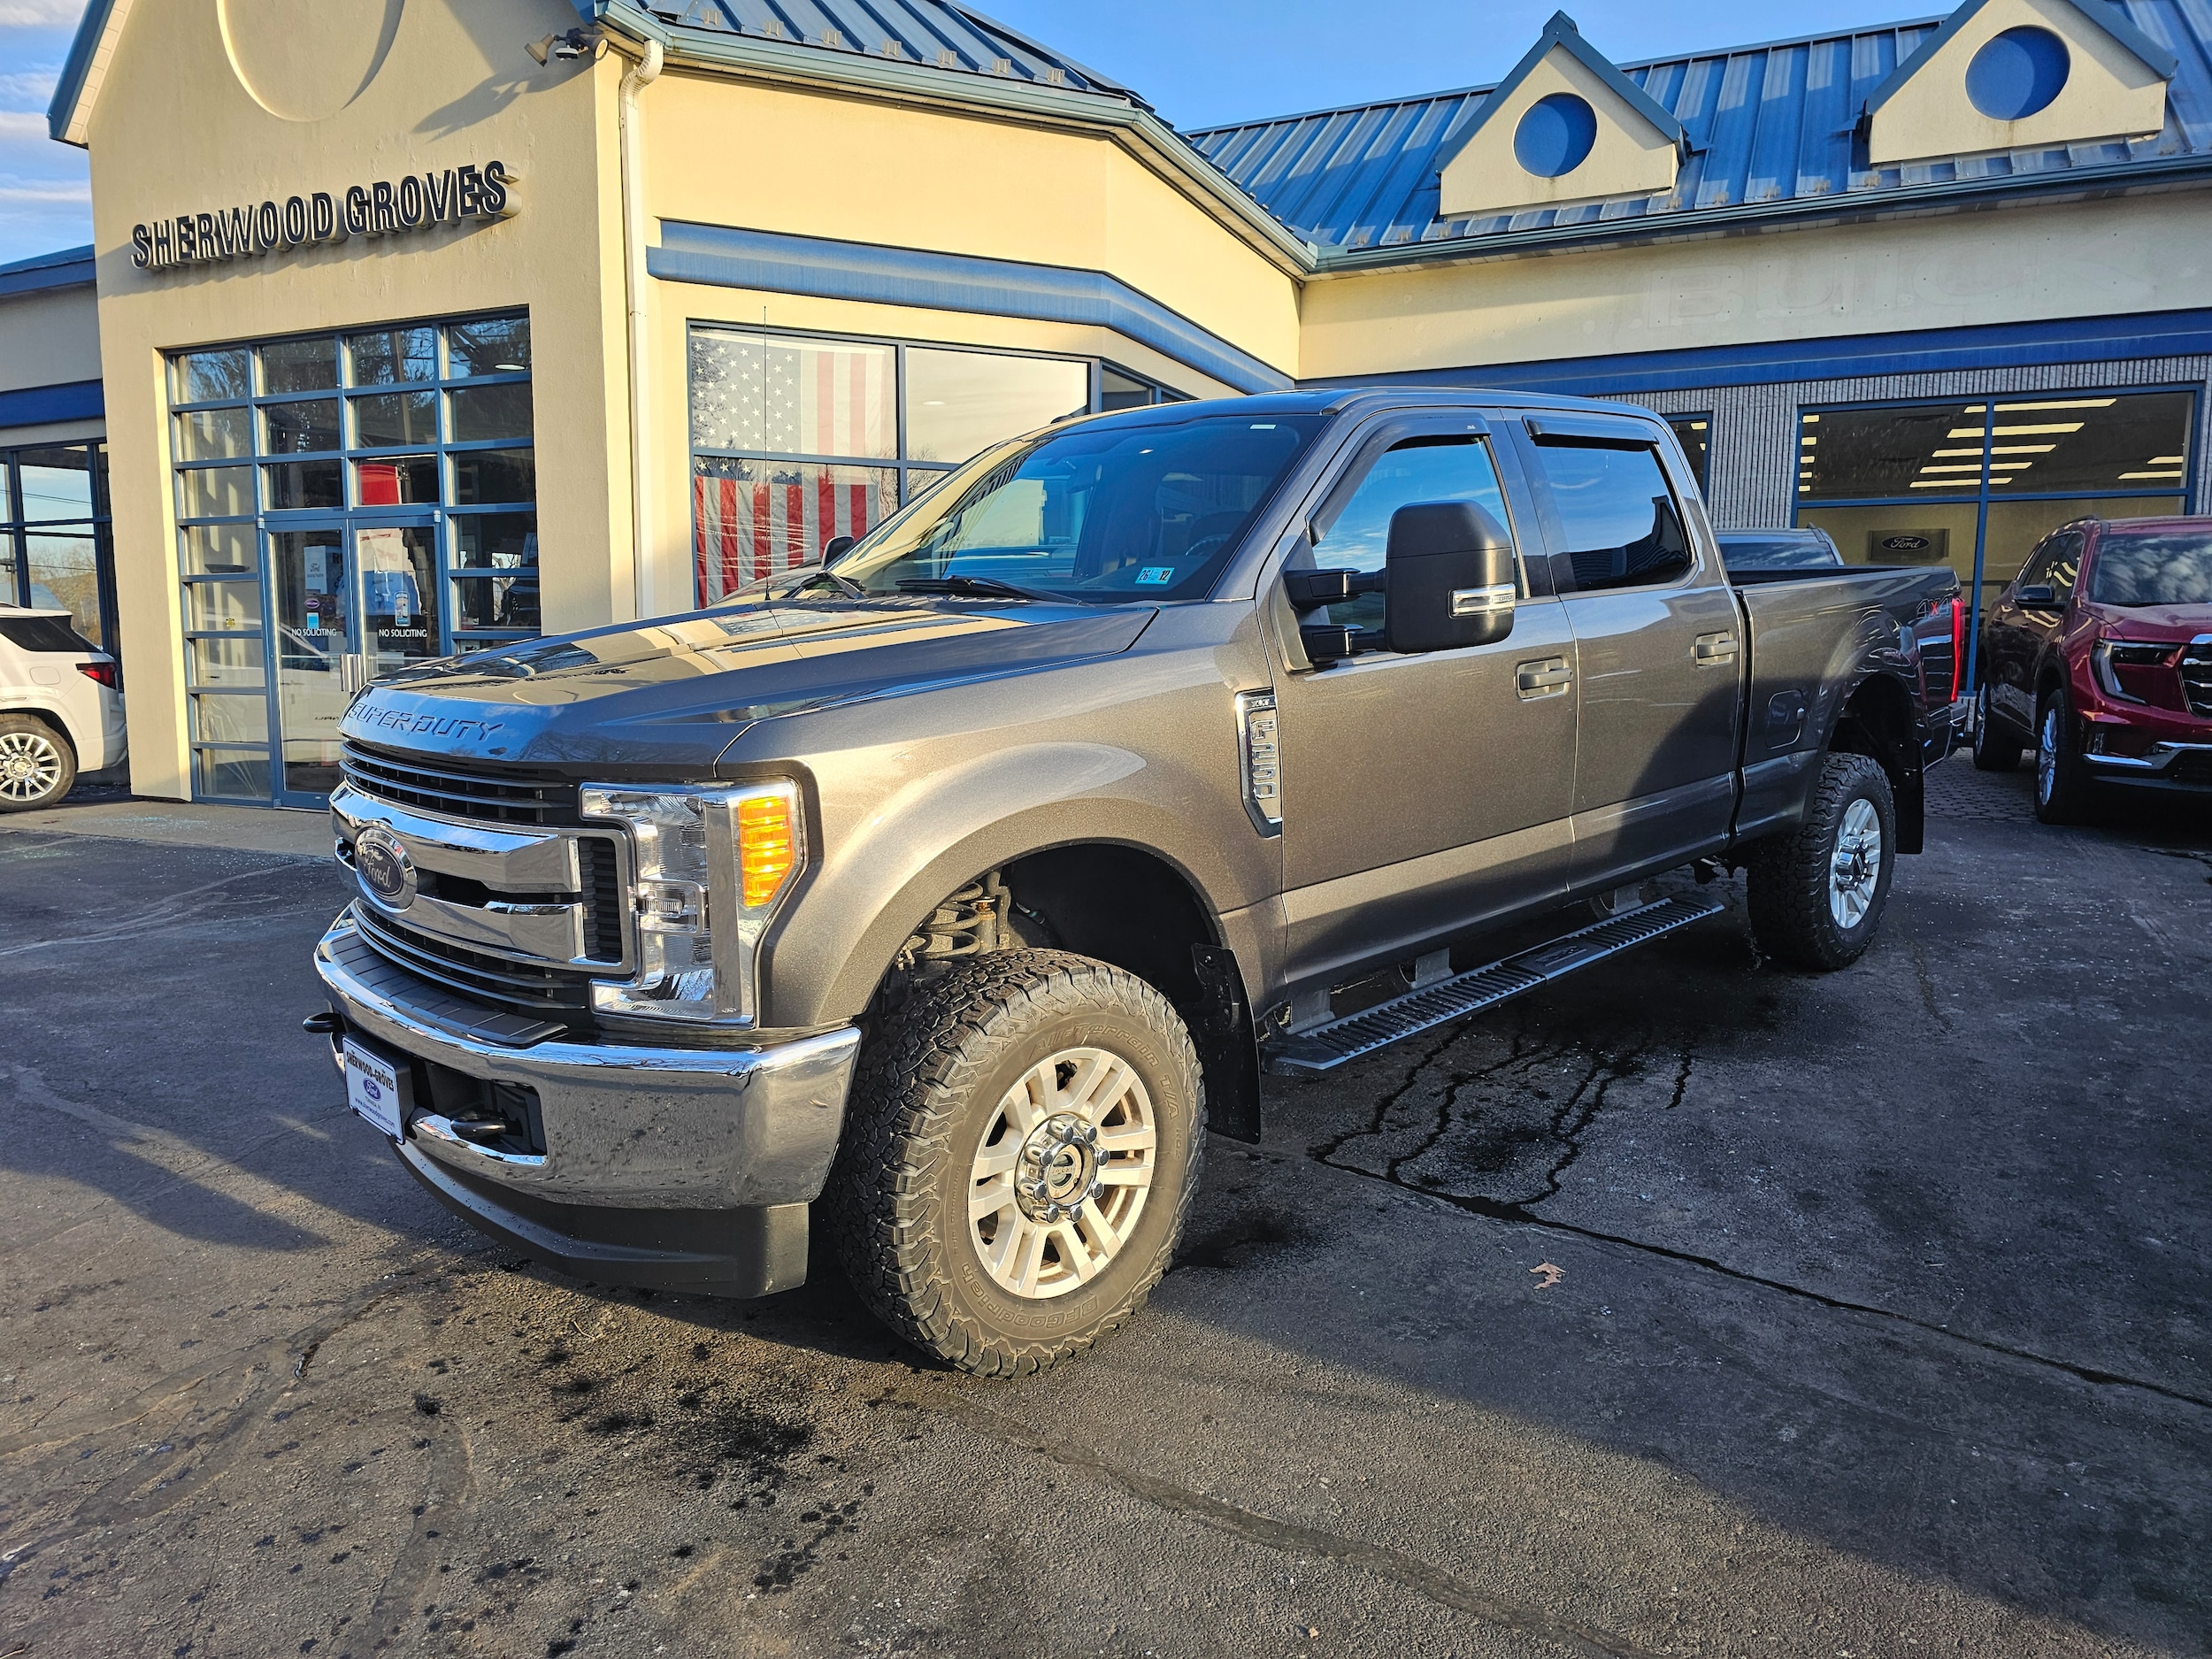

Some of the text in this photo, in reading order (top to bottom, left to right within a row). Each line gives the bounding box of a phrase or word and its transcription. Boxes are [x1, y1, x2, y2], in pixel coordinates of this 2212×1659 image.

[131, 160, 511, 269] SHERWOOD GROVES
[1890, 537, 1921, 549] Ford
[1139, 569, 1151, 581] 26
[1158, 569, 1171, 581] 12
[291, 628, 337, 637] NO SOLICITING
[379, 628, 427, 637] NO SOLICITING
[348, 702, 505, 741] SUPER DUTY
[363, 849, 392, 888] Ford
[346, 1050, 395, 1093] SHERWOOD-GROVES
[365, 1080, 380, 1098] Ford
[1158, 1073, 1179, 1120] T/A
[961, 1262, 1099, 1329] BFGoodrich
